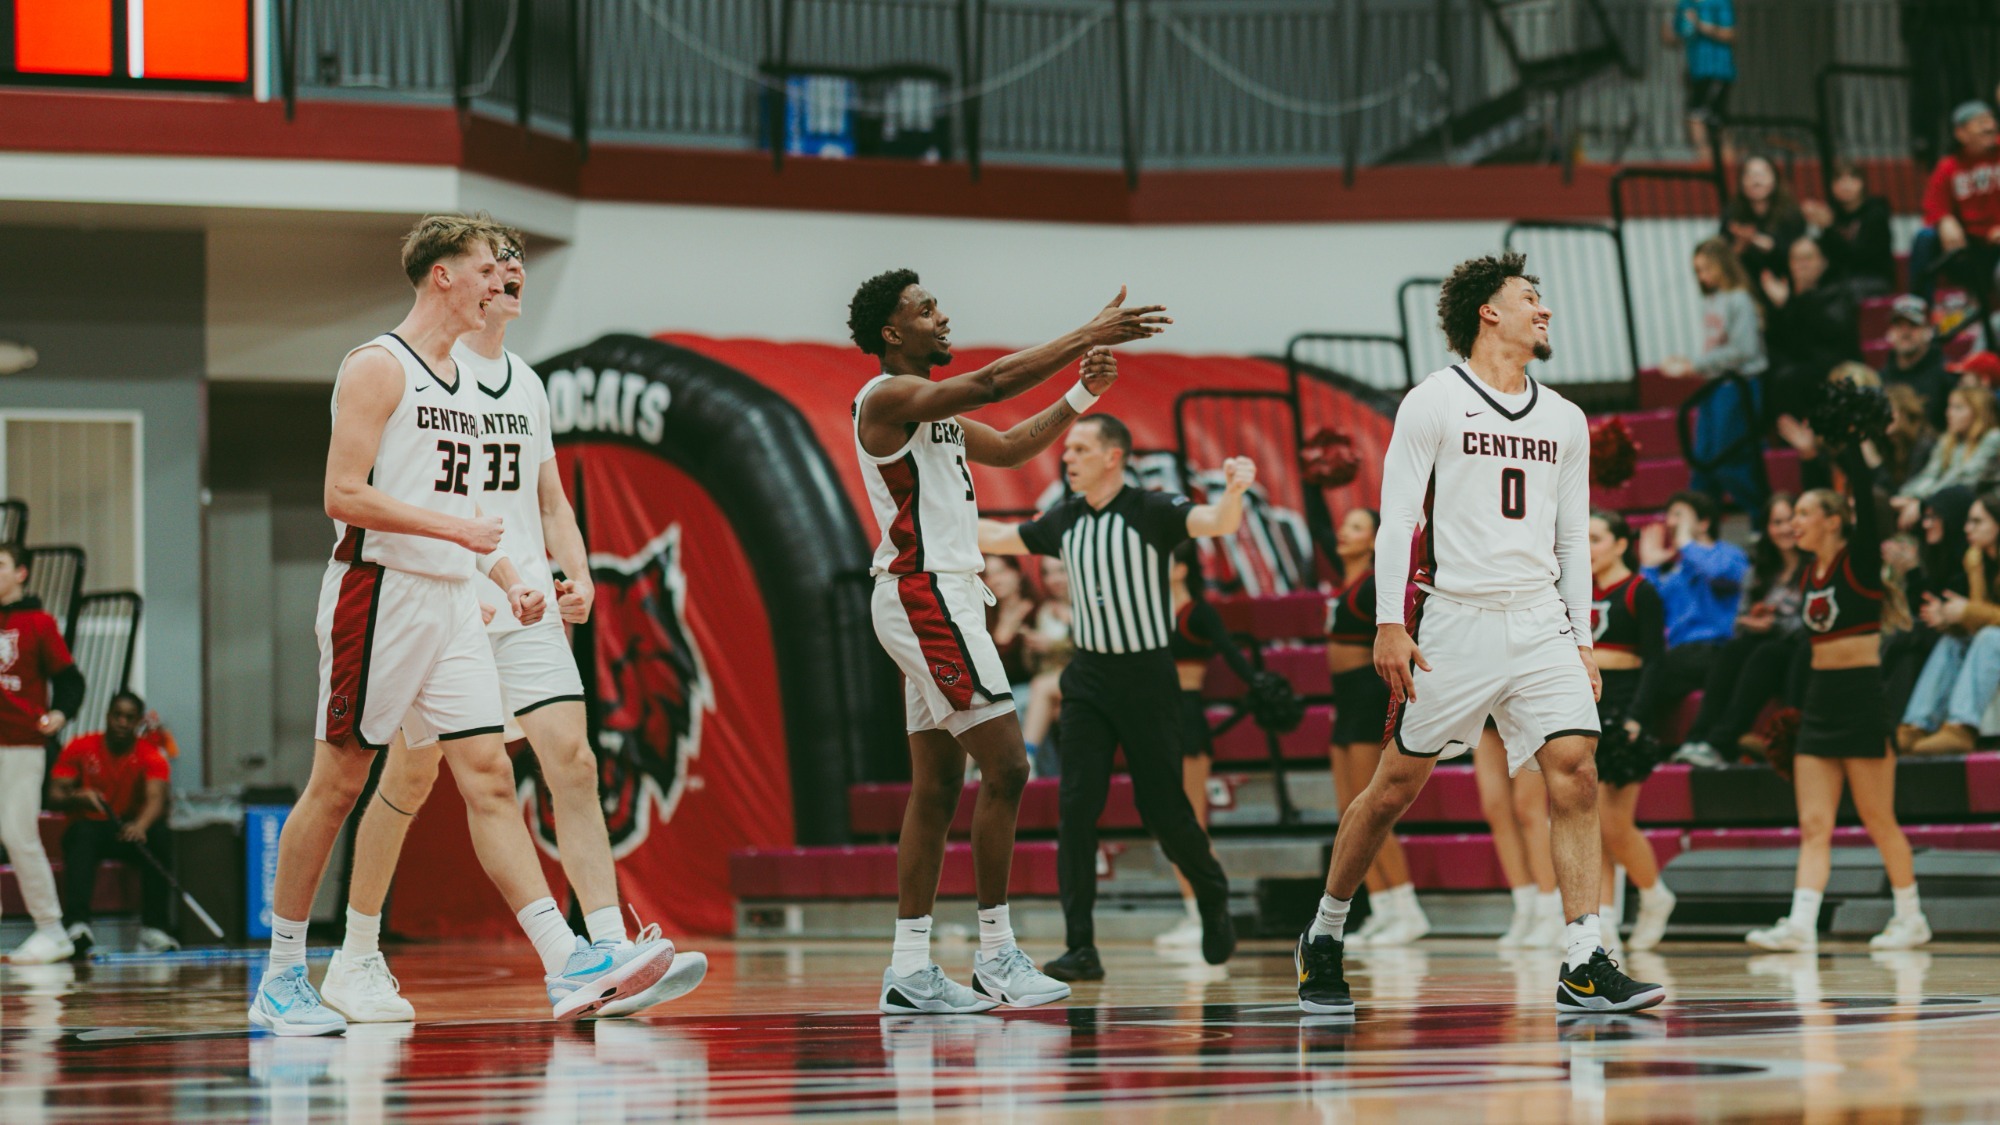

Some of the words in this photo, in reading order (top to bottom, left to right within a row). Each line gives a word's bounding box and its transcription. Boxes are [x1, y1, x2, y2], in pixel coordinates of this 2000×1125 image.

[481, 413, 533, 436] NTRA
[547, 366, 672, 445] DCATS
[931, 422, 966, 447] CEN
[434, 439, 472, 497] 32
[482, 443, 521, 492] 33
[1501, 467, 1527, 520] 0
